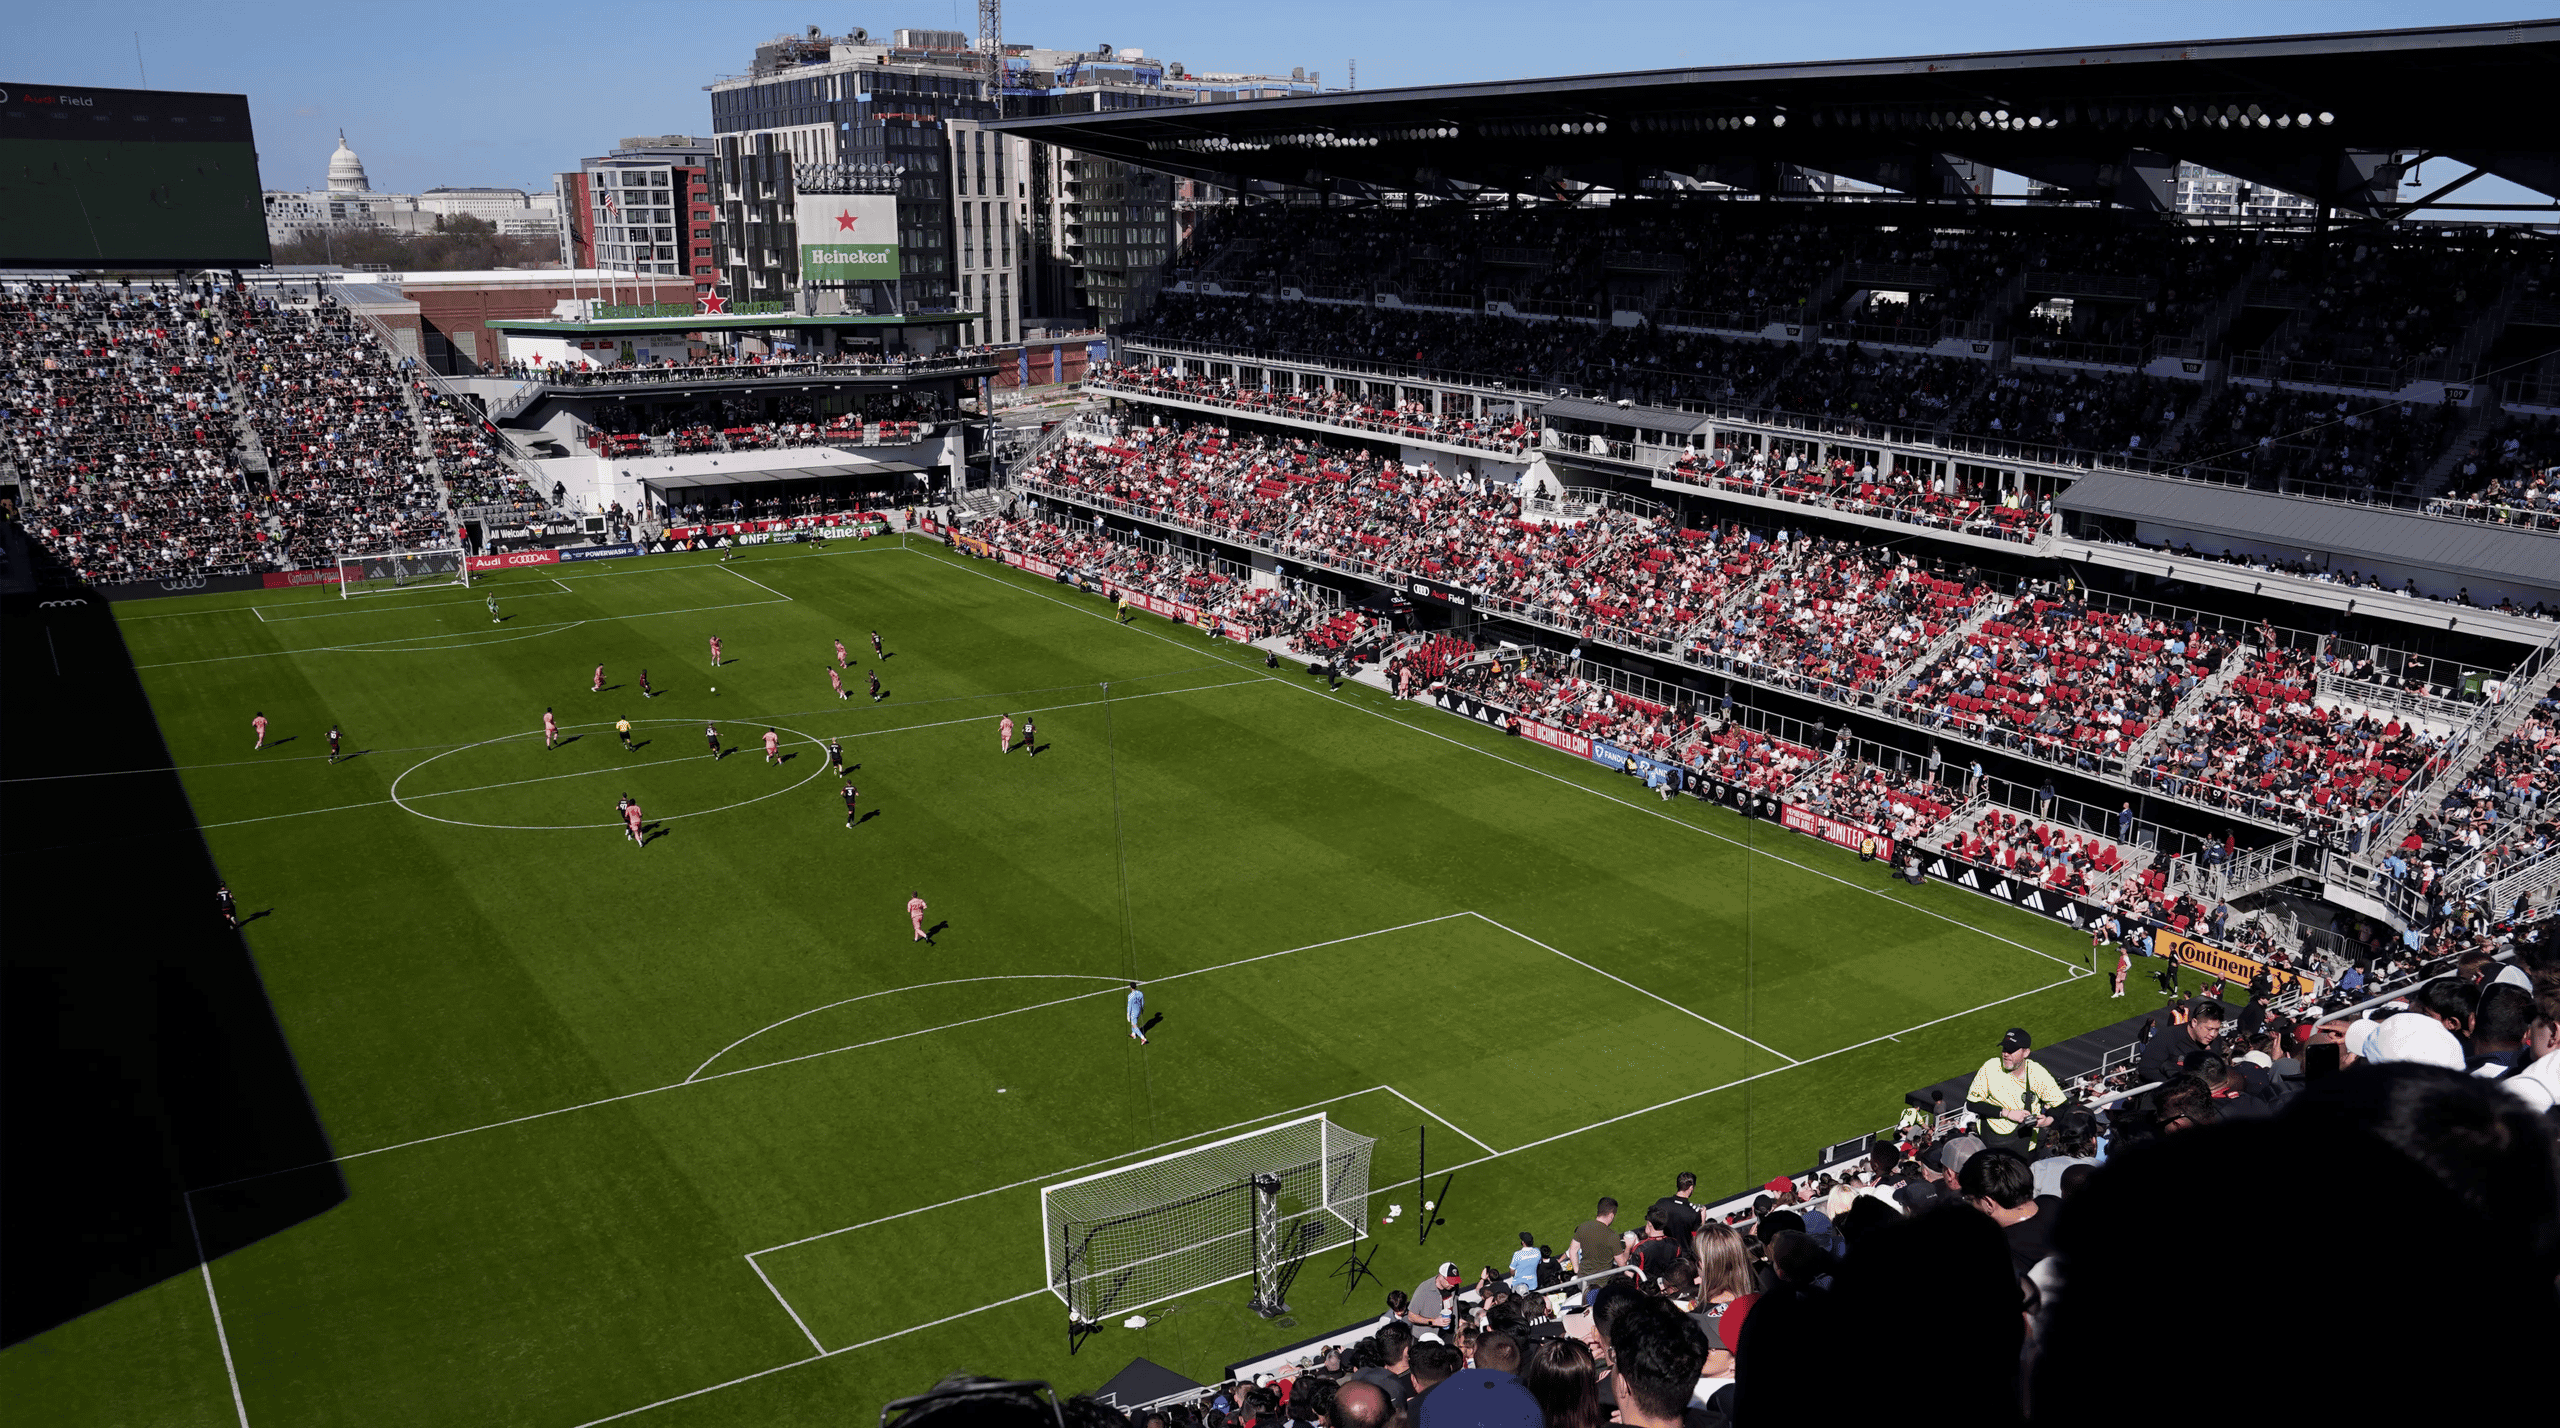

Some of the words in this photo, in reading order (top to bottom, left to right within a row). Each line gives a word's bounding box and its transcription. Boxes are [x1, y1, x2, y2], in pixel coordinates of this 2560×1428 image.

[23, 93, 56, 104] Audi
[60, 95, 94, 107] Field
[2185, 363, 2198, 373] 108
[2449, 389, 2463, 399] 109
[491, 529, 500, 540] All
[500, 527, 530, 539] Welcome
[546, 526, 556, 536] All
[556, 523, 576, 536] United
[748, 533, 770, 545] NFP
[585, 548, 627, 558] POWERWASH
[475, 555, 501, 567] Audi
[287, 572, 314, 585] Captain
[314, 569, 339, 582] Morgan
[1431, 589, 1448, 601] Audi
[1448, 593, 1465, 606] Field
[1537, 724, 1589, 756] DCUNITED.COM
[1786, 814, 1815, 833] AVAILABLE
[2178, 941, 2256, 979] Continent
